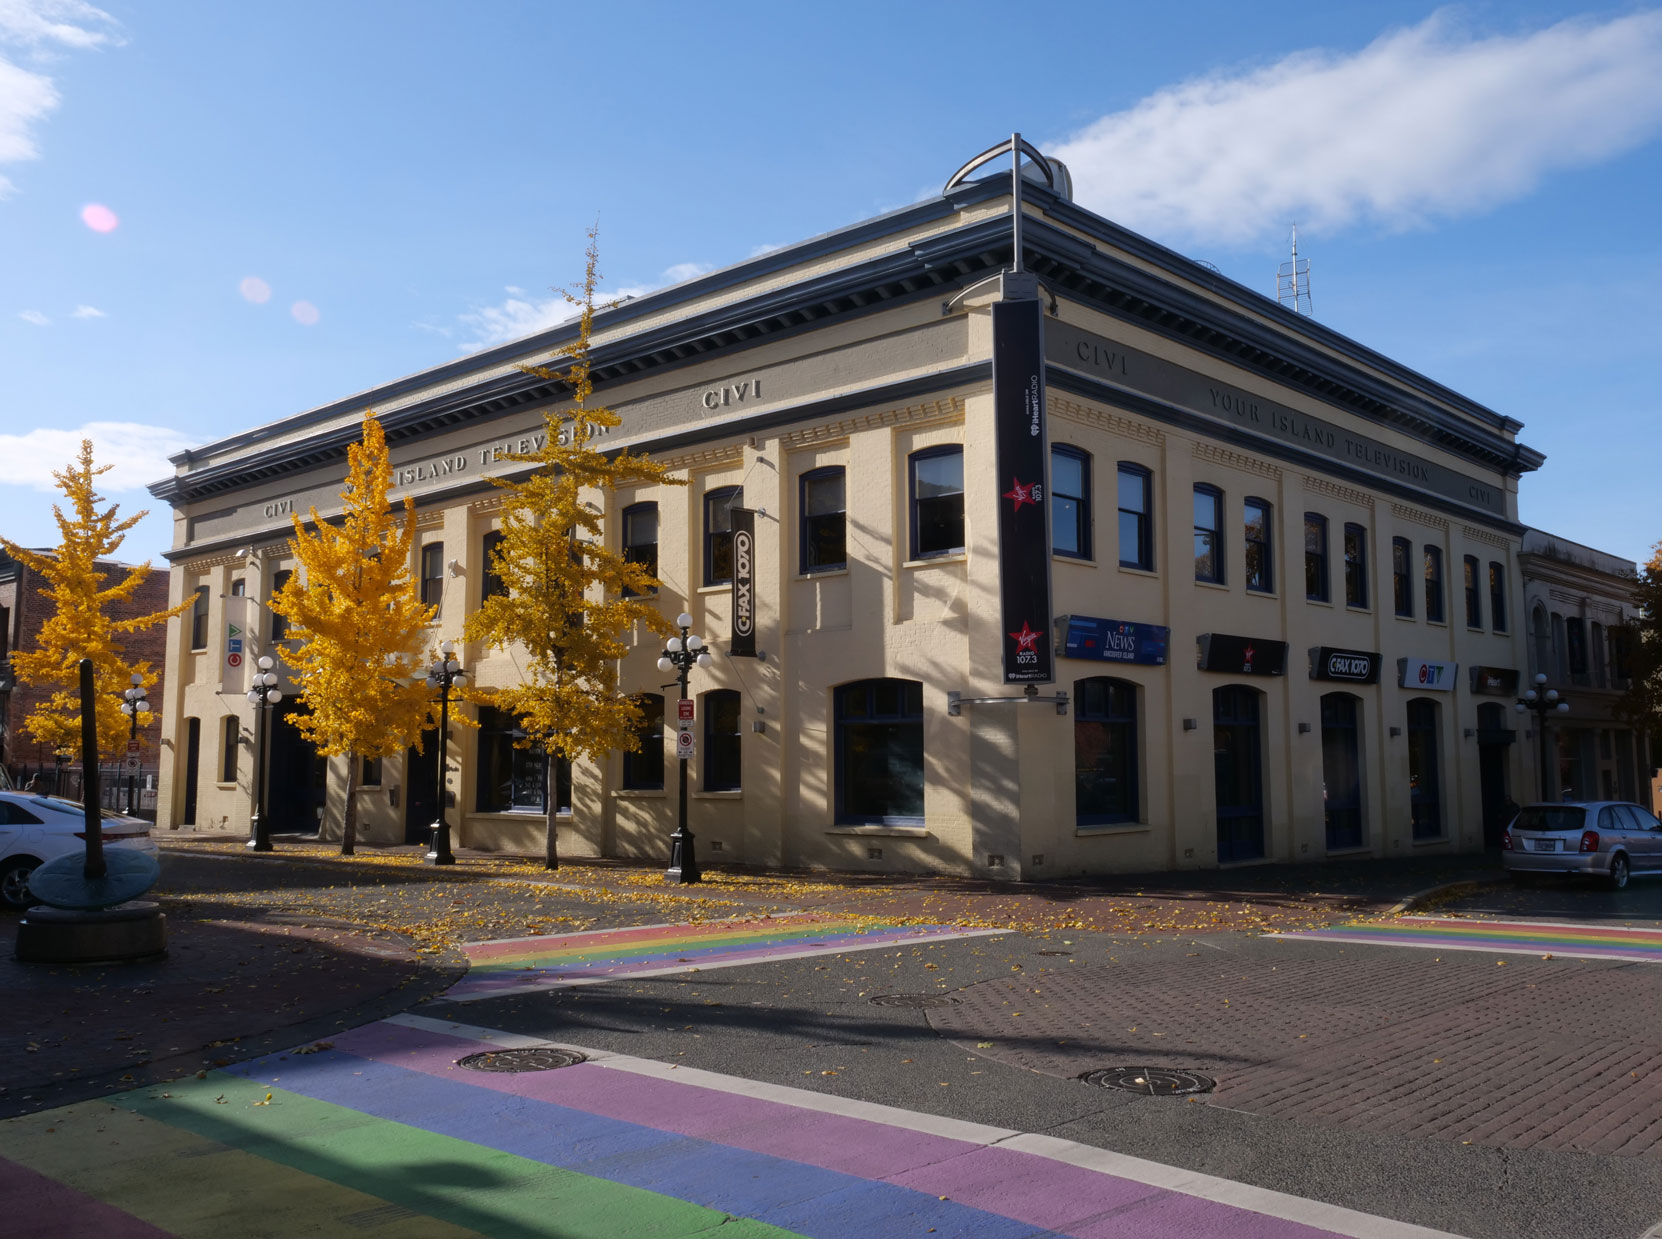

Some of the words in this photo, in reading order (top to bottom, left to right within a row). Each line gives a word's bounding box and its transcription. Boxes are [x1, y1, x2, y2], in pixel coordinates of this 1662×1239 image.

[1077, 341, 1127, 375] CIVI
[703, 379, 760, 408] CIVI
[1210, 388, 1259, 422] YOUR
[1272, 411, 1335, 448] ISLAND
[1345, 439, 1429, 481] TELEVISION
[397, 455, 467, 487] ISLAND
[1469, 484, 1491, 505] CIVI
[264, 500, 293, 518] CIVI
[737, 535, 750, 579] 1070
[1119, 624, 1134, 634] CTV
[1016, 655, 1038, 664] 107.3
[1351, 660, 1368, 674] 1070
[1419, 664, 1444, 684] CTV
